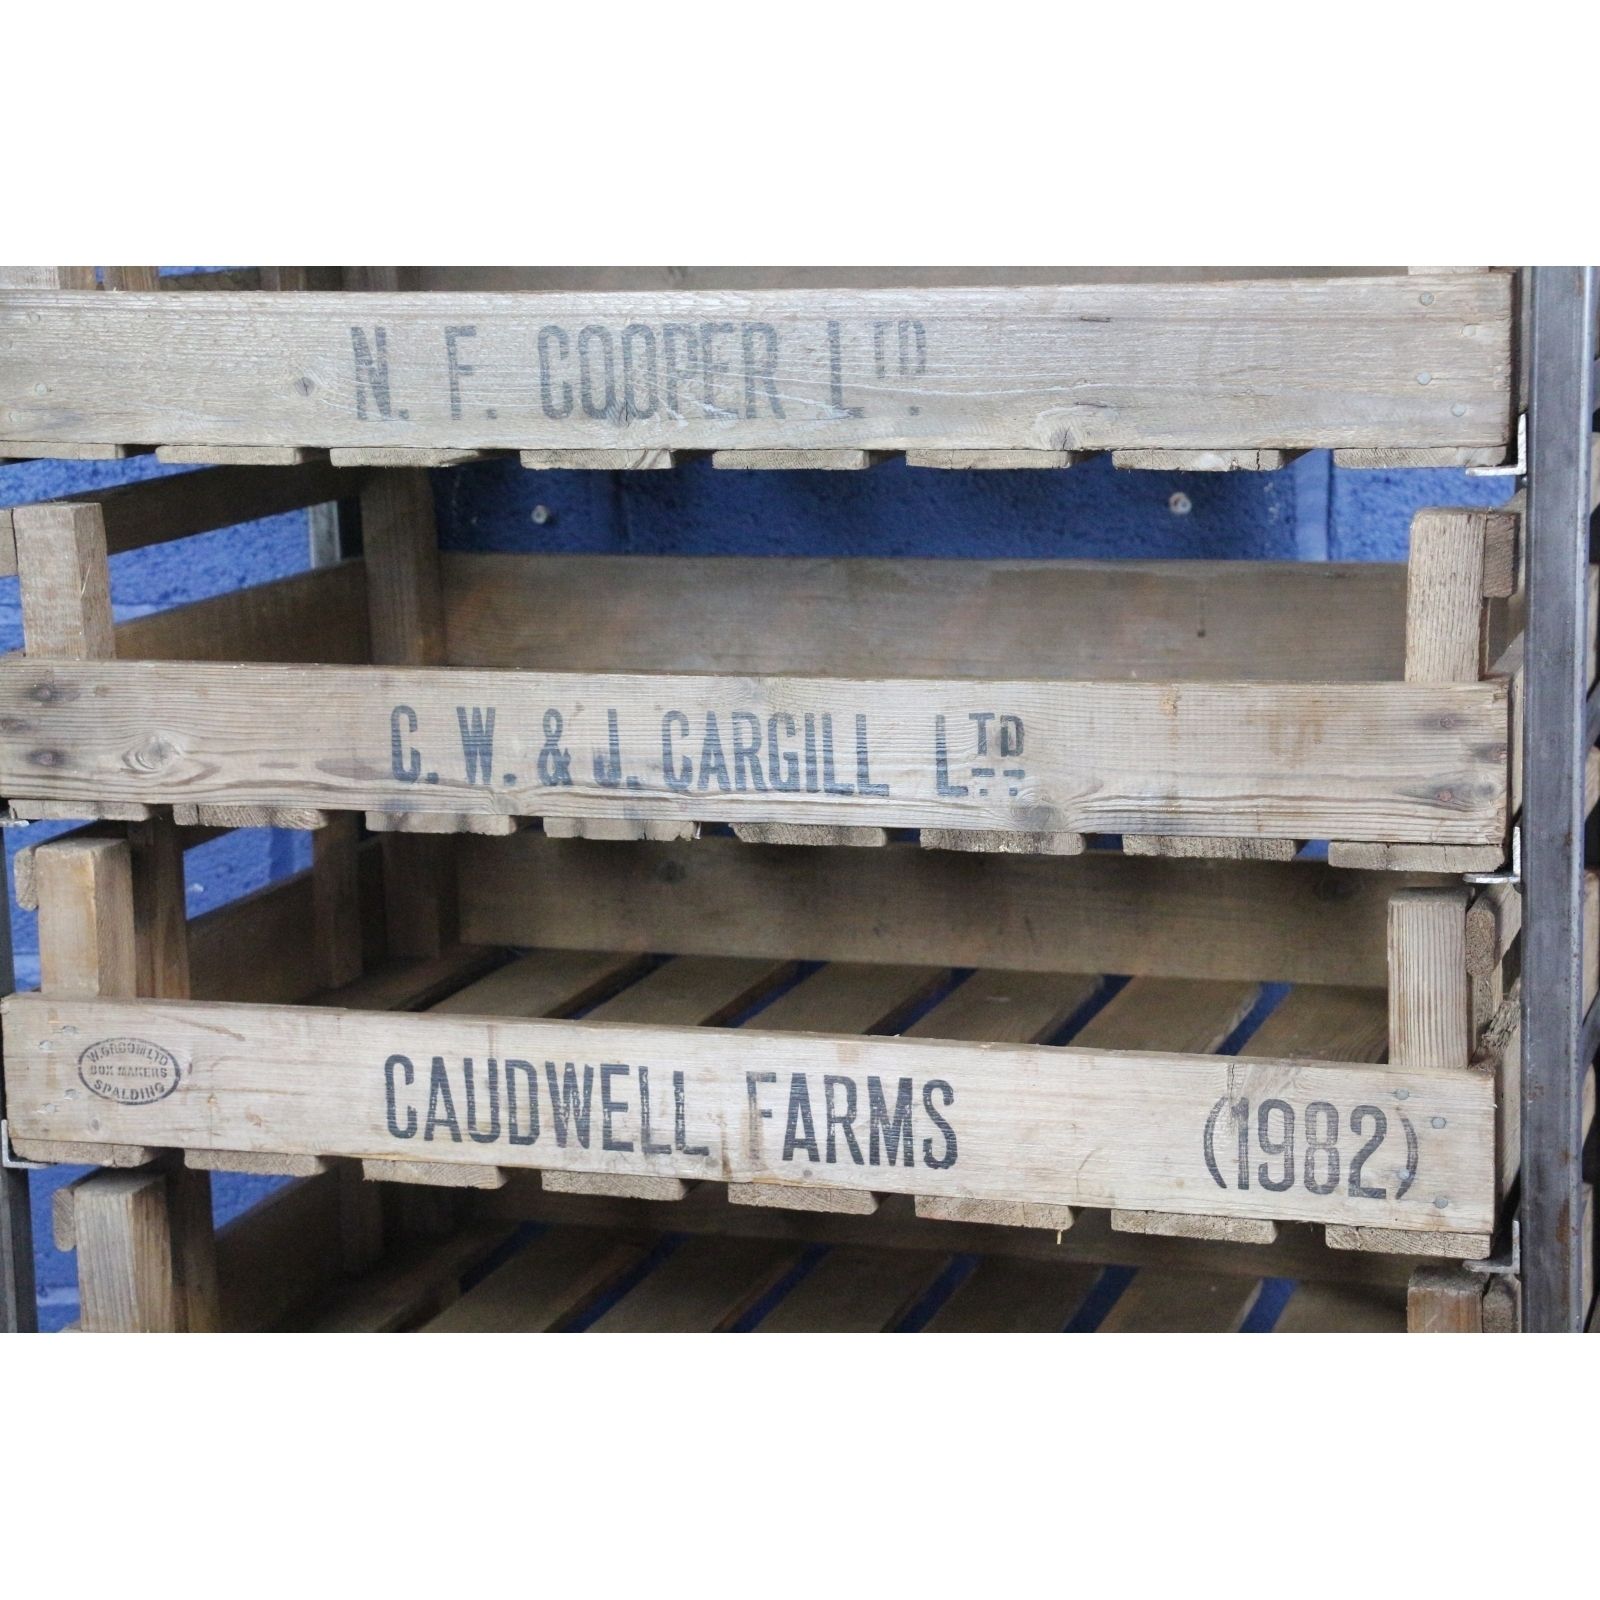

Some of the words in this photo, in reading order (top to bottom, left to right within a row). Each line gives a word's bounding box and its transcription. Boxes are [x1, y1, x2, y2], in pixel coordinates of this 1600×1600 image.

[350, 326, 409, 420] N.
[444, 325, 498, 420] F.
[537, 321, 787, 420] COOPER
[390, 704, 439, 785] C.
[456, 706, 517, 786] W.
[537, 708, 573, 786] &
[593, 708, 641, 790] J.
[662, 709, 890, 797] CARGILL
[94, 1079, 165, 1100] SPALDING
[118, 1066, 168, 1078] MAKERS
[384, 1054, 710, 1157] CAUDWELL
[745, 1070, 958, 1170] FARMS
[1203, 1096, 1419, 1200] (1982)
